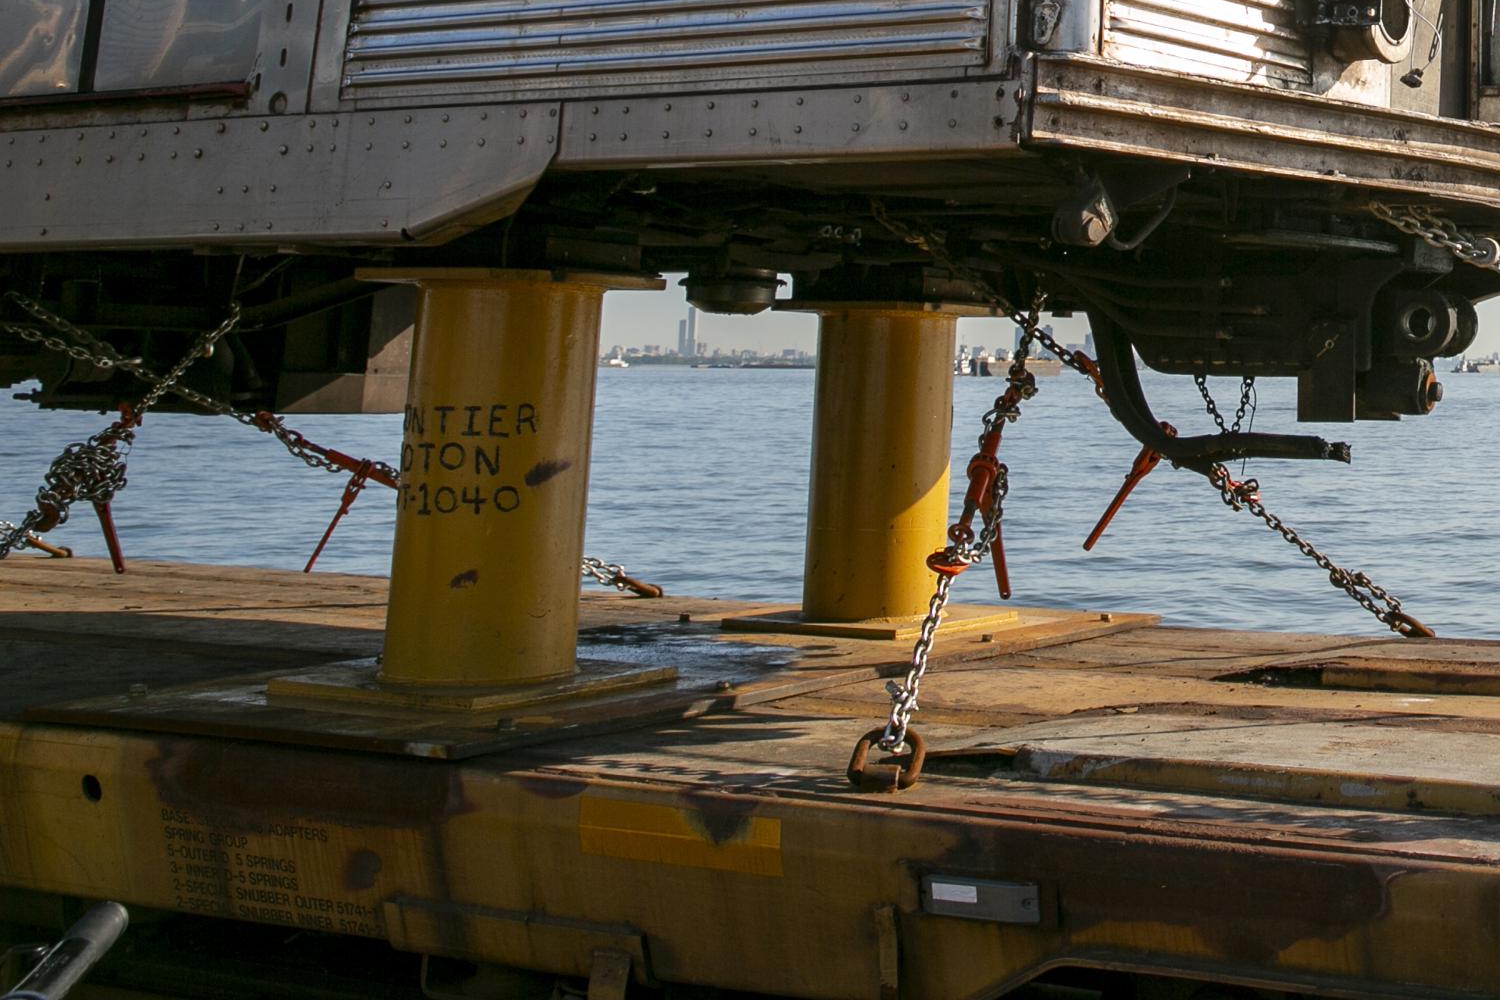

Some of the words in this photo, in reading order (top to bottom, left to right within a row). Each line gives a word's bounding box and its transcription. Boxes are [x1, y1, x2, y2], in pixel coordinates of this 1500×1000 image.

[164, 826, 204, 843] SPRING
[209, 832, 248, 848] GROUP
[268, 823, 329, 842] ADAPTERS
[246, 854, 296, 873] SPRINGS
[248, 871, 298, 890] SPRINGS
[173, 878, 233, 898] 2-SPECIL
[236, 887, 290, 905] SNUBBER
[295, 895, 333, 912] OUTER
[239, 904, 293, 922] SNUBBER
